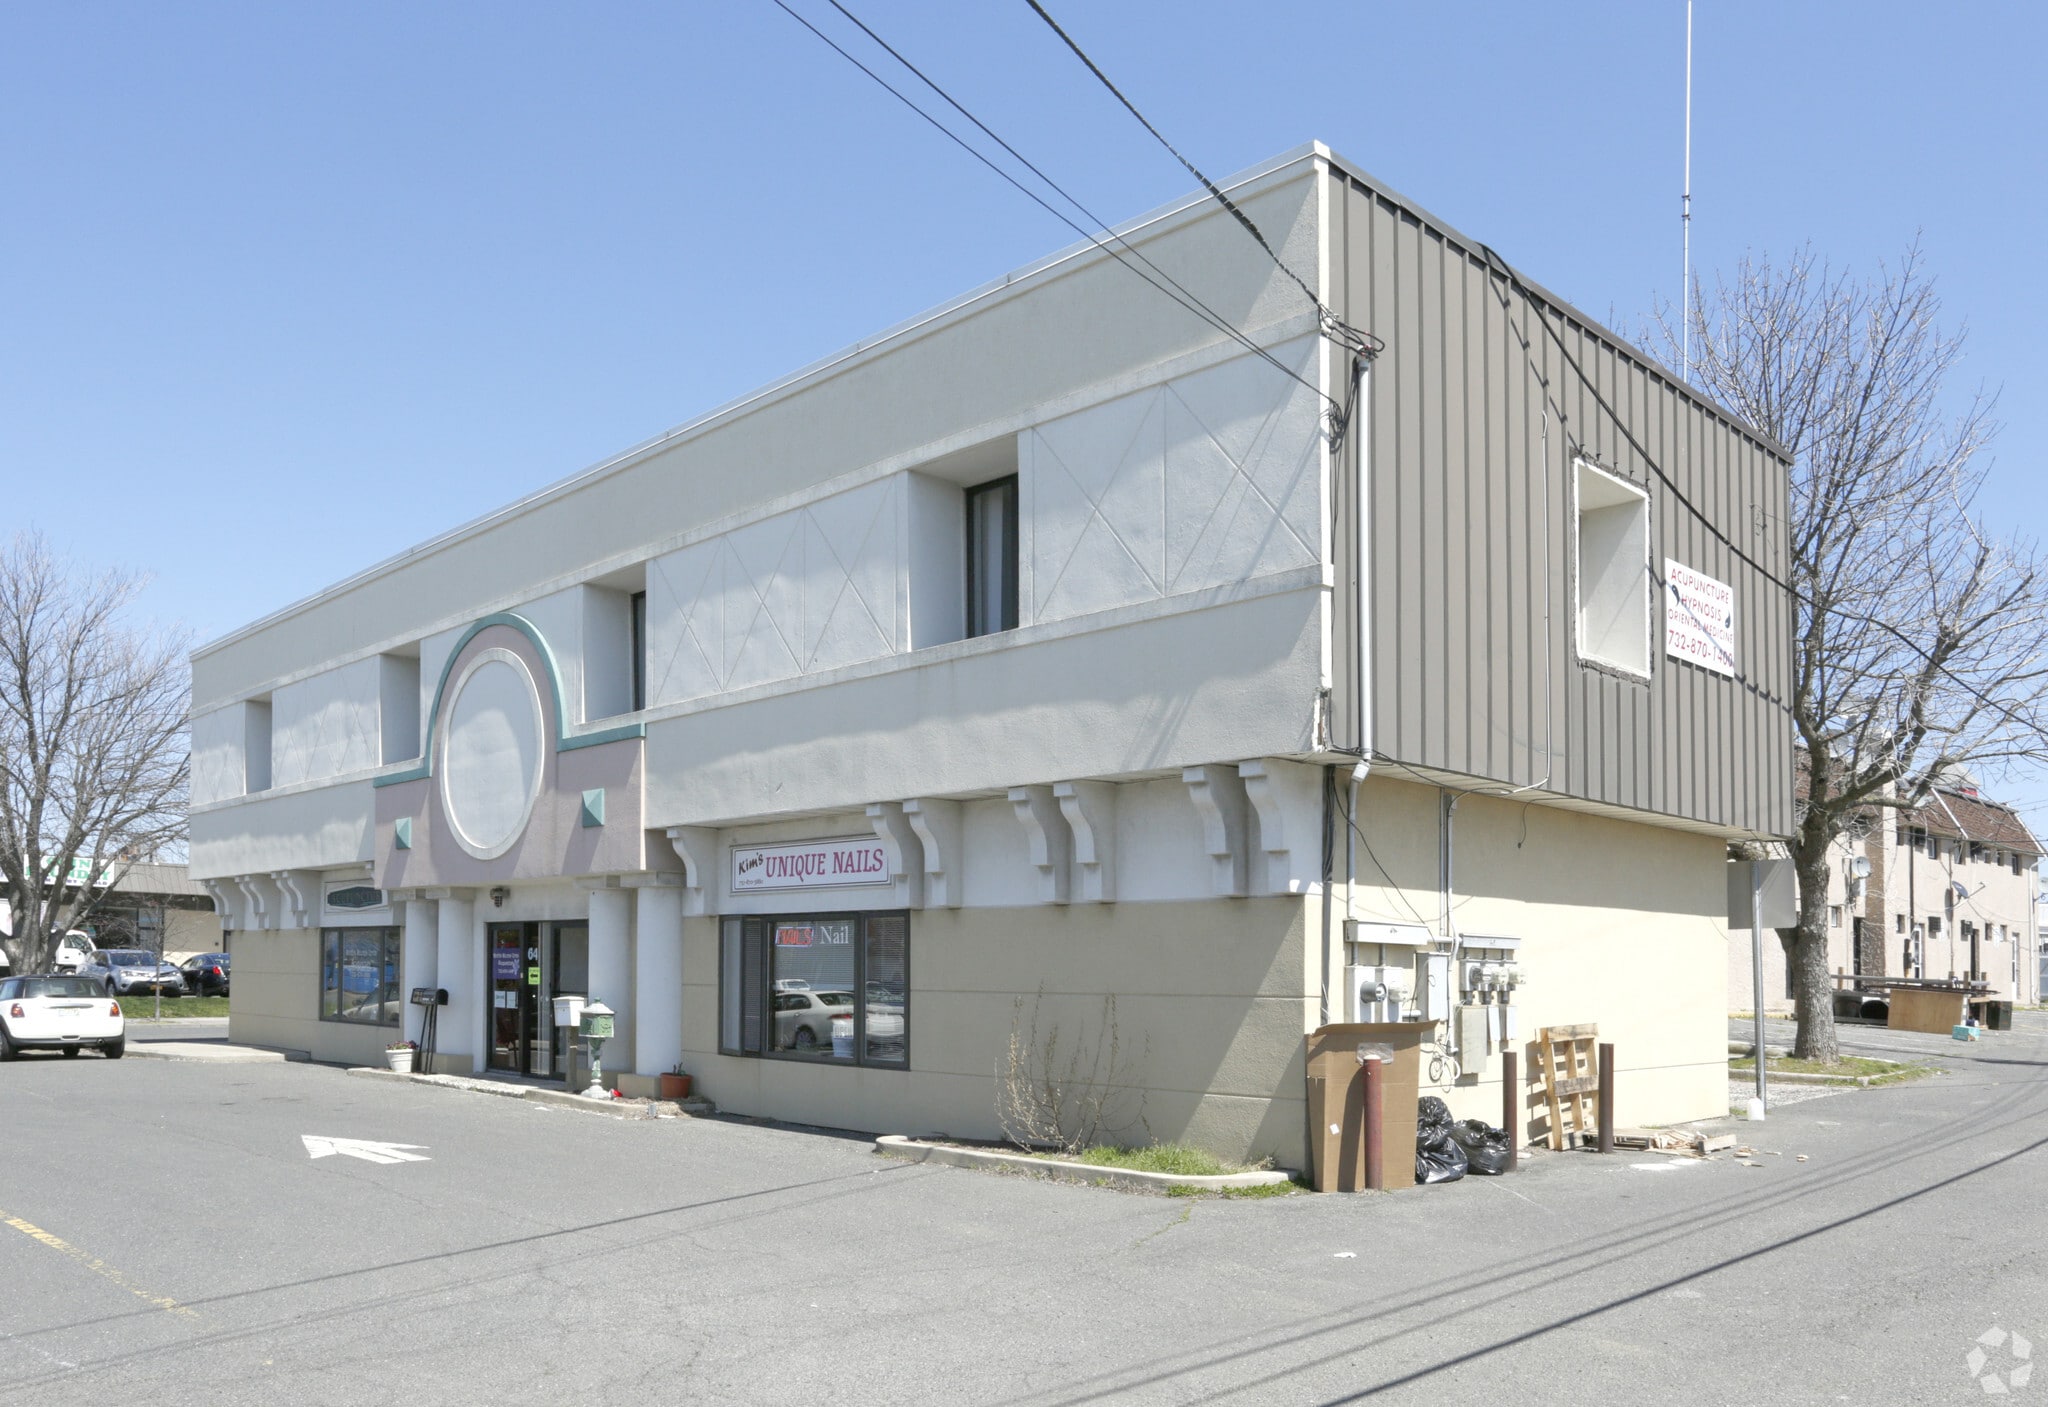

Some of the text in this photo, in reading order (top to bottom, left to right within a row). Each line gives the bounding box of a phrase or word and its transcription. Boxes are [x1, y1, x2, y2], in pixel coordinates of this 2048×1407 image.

[1671, 568, 1729, 604] ACUPUNCTURE
[1681, 593, 1722, 622] HYPNOSIS
[1668, 608, 1733, 644] ORIENTAL MEDICINE
[1668, 630, 1733, 668] 732-870-1400
[738, 848, 884, 882] Kim's UNIQUE NAILS
[777, 928, 812, 945] NAILS
[819, 926, 849, 945] Nail
[527, 947, 538, 961] 64
